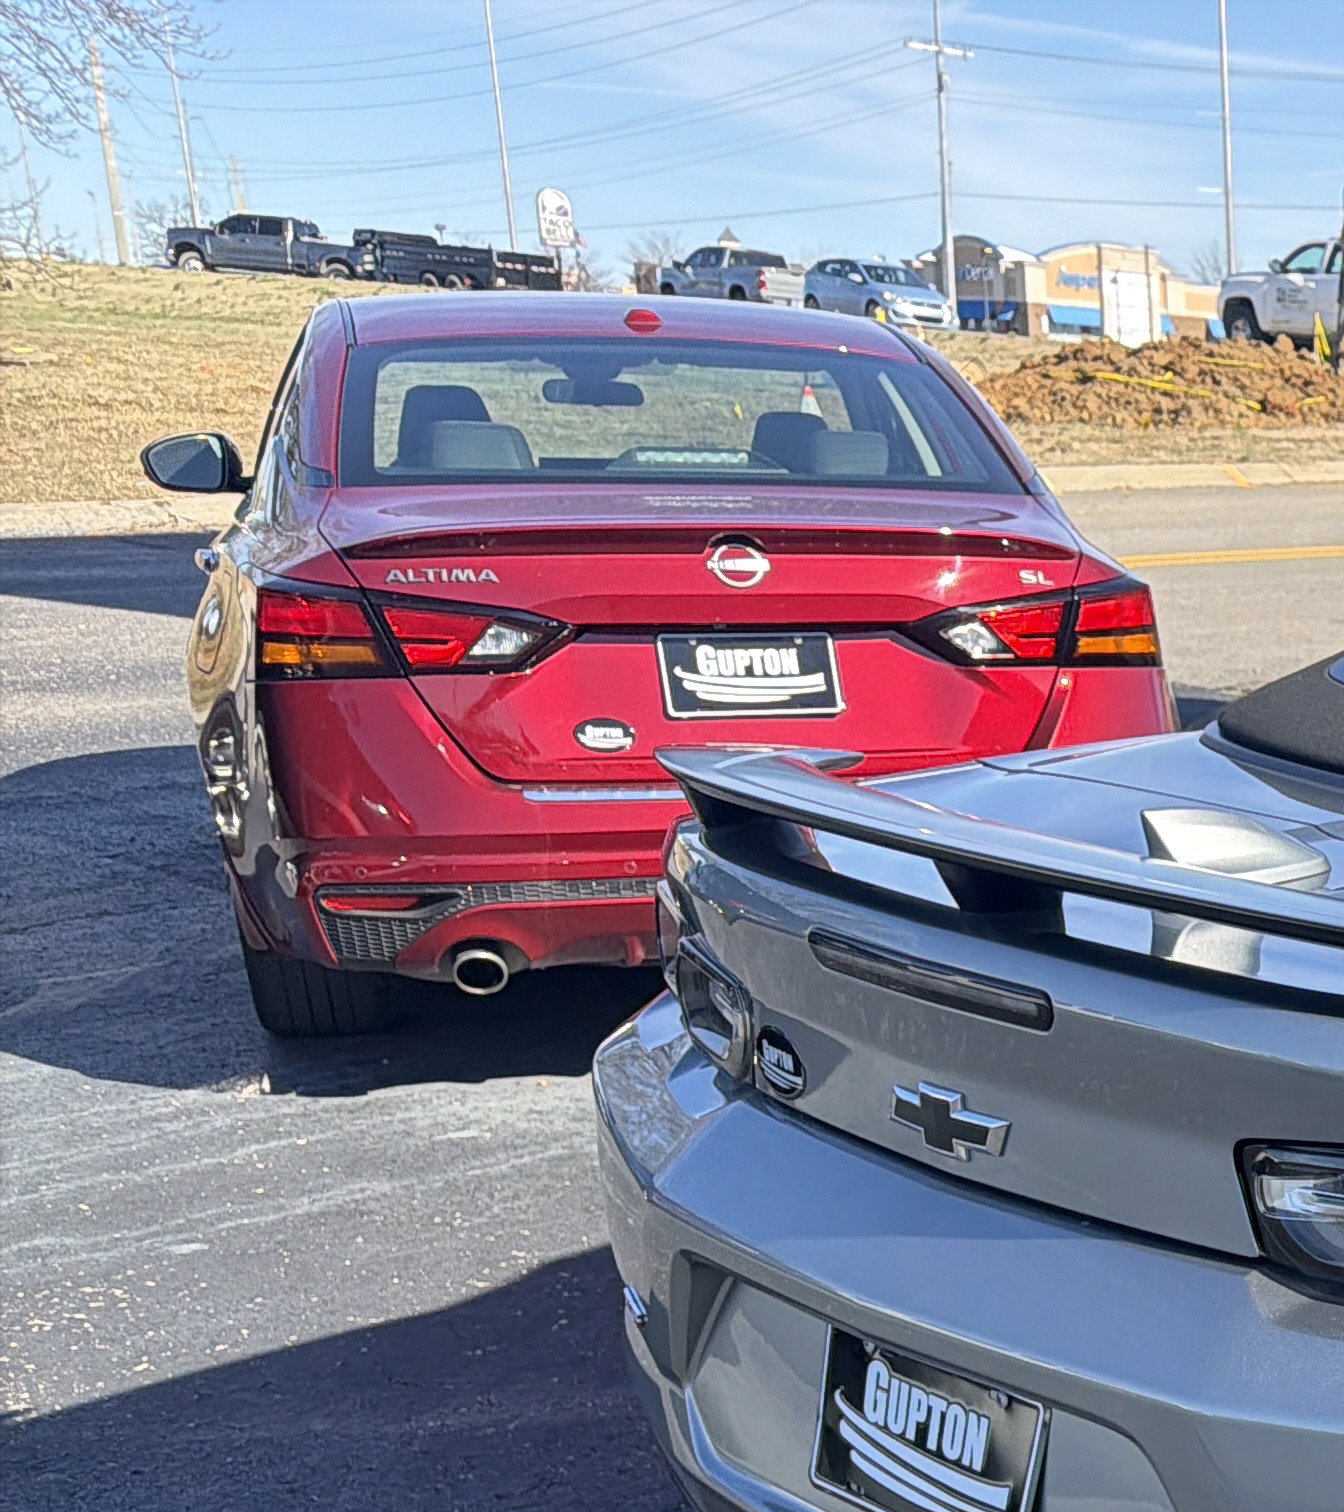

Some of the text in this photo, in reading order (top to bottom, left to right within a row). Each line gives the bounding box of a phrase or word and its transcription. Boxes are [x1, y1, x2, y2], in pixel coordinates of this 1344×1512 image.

[385, 568, 500, 584] ALTIMA
[1018, 569, 1055, 586] SL
[695, 644, 800, 677] GUPTON
[863, 1358, 990, 1474] GUPTON
